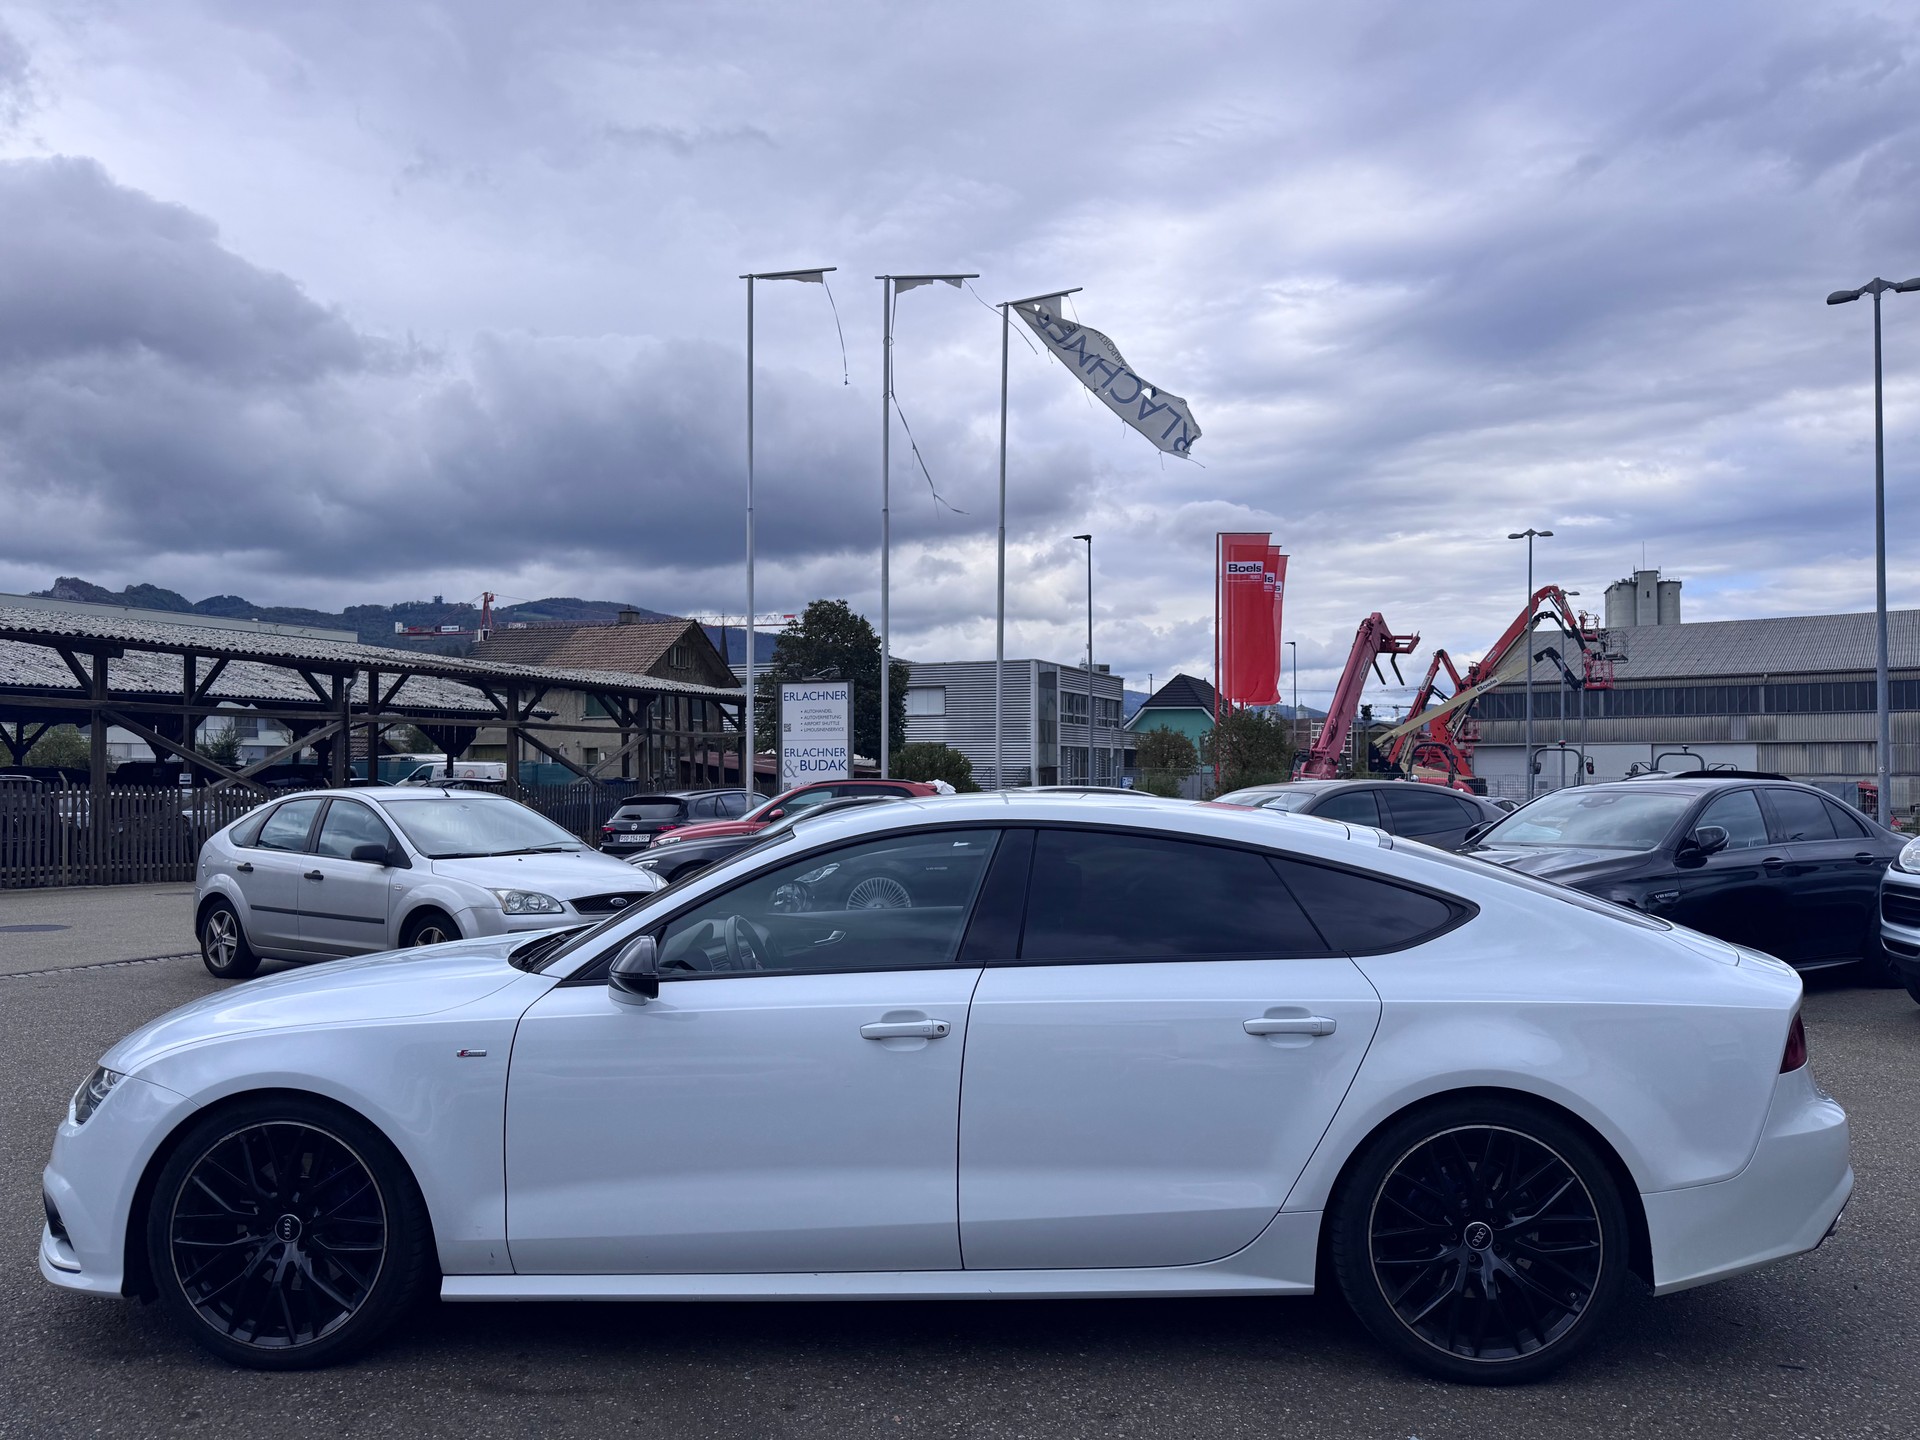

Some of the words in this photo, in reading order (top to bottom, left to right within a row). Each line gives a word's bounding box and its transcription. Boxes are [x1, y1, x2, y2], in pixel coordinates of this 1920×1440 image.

[1228, 563, 1262, 573] Boels
[1476, 679, 1498, 692] Boels
[783, 690, 847, 701] ERLACHNER
[784, 748, 846, 758] ERLACHNER
[783, 759, 799, 778] &
[800, 759, 847, 771] BUDAK
